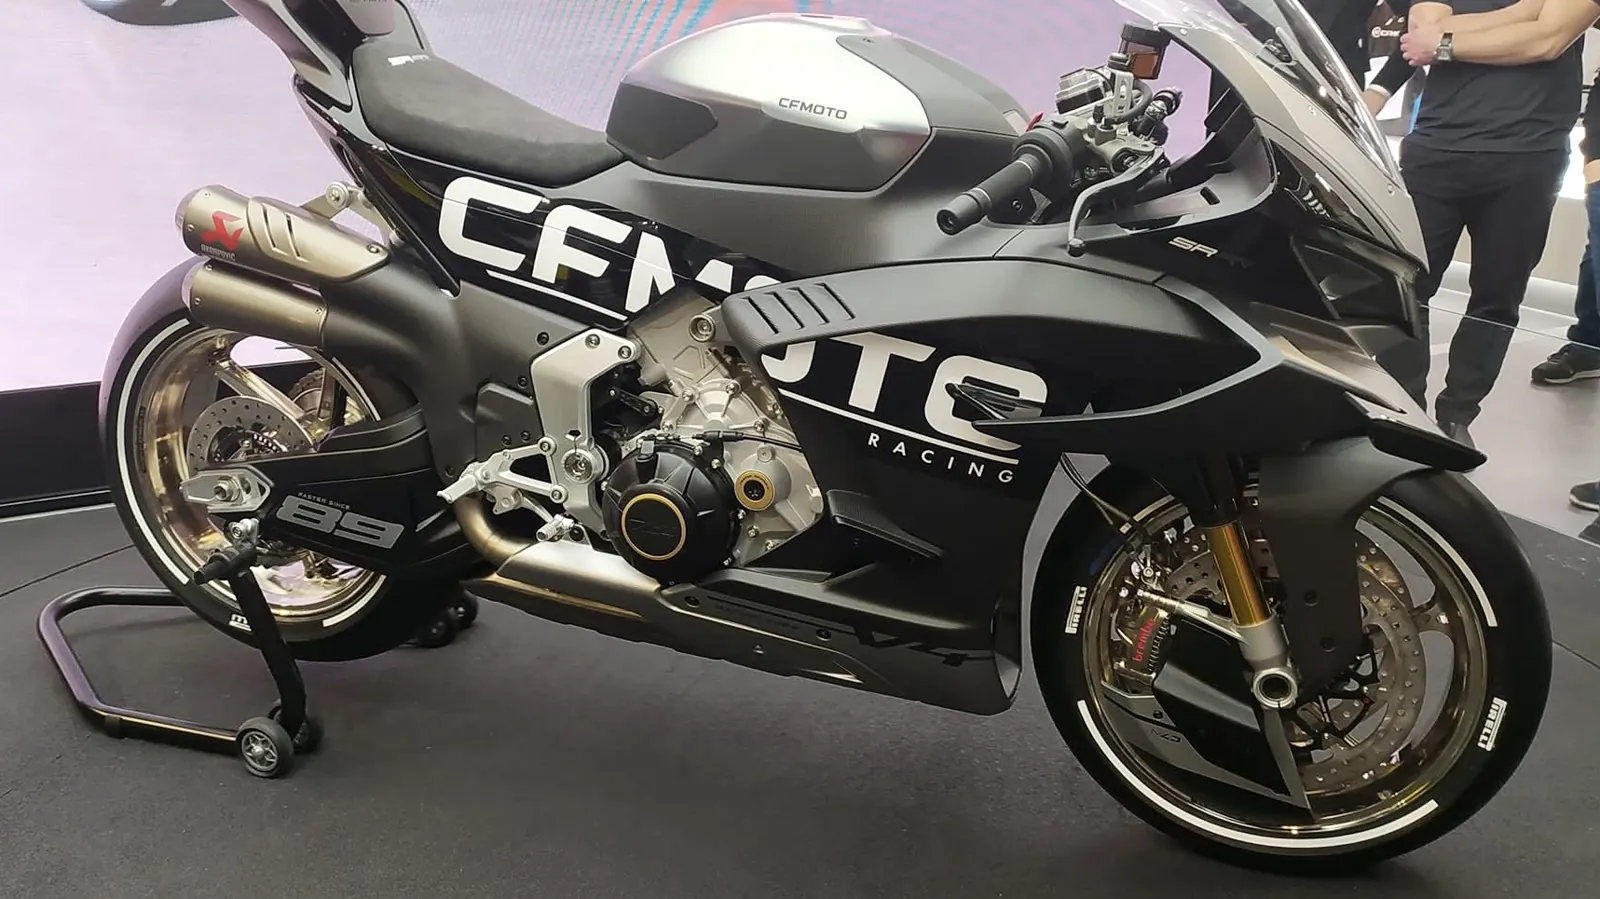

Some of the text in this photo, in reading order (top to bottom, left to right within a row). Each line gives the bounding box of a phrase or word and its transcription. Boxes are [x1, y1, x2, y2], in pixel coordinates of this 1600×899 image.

[778, 97, 848, 120] CFMOTO
[1168, 236, 1219, 258] SR
[867, 432, 1014, 484] RACING
[276, 494, 405, 549] 89
[1065, 586, 1088, 634] PIRELLI
[1132, 618, 1156, 662] brembo
[1477, 697, 1508, 752] PIRELLI
